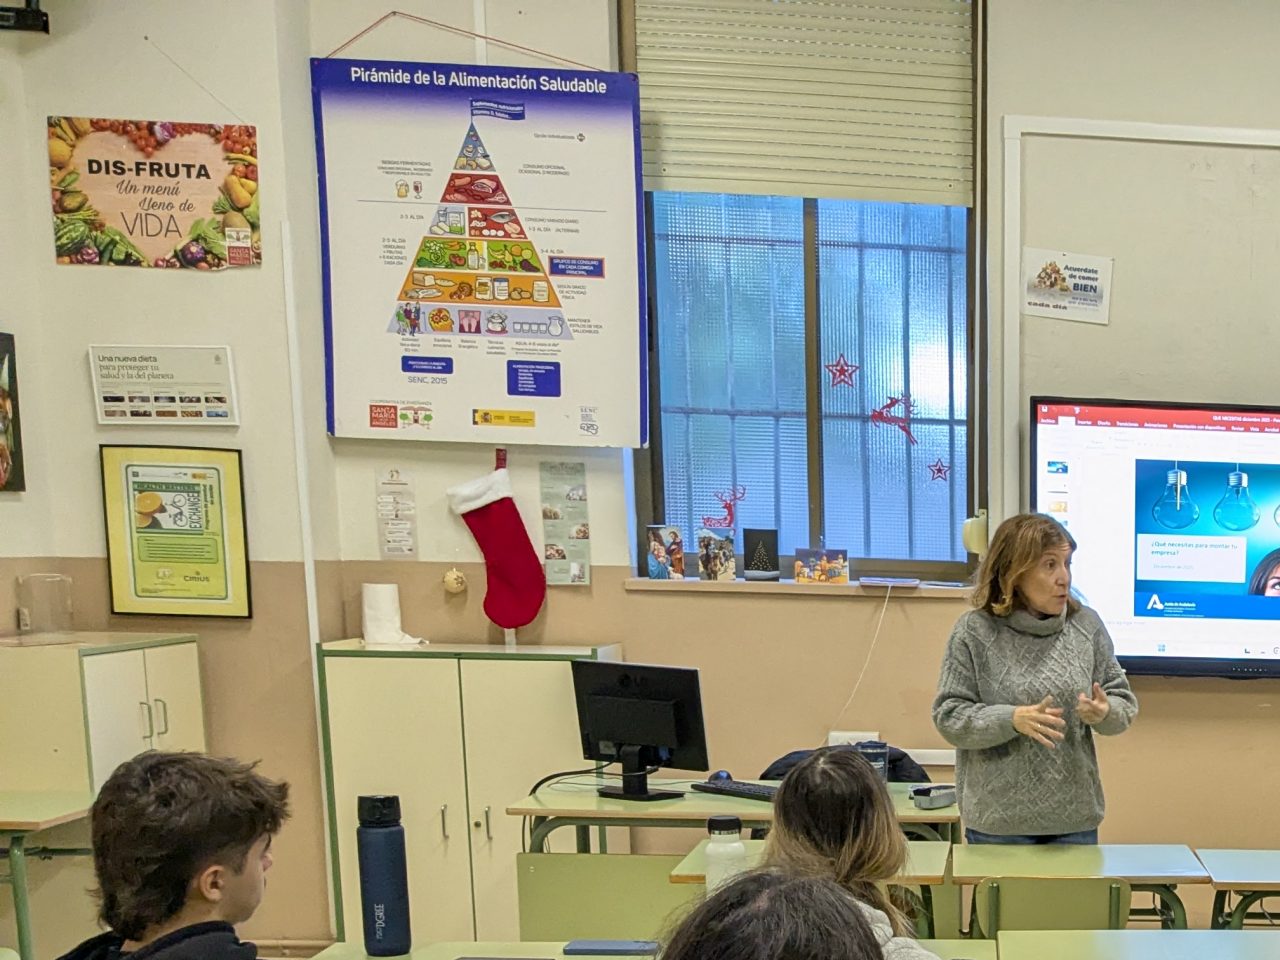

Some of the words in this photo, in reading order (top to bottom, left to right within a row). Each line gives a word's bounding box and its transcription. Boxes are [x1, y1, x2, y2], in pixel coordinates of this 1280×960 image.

[350, 67, 411, 84] Pirámide
[414, 69, 430, 85] de
[434, 70, 446, 86] la
[448, 71, 537, 90] Alimentación
[540, 77, 607, 94] Saludable
[88, 159, 211, 180] DIS-FRUTA
[116, 180, 139, 194] Un
[142, 181, 180, 196] menú
[179, 199, 196, 212] de
[120, 212, 182, 238] VIDA
[1073, 283, 1097, 293] BIEN
[147, 372, 174, 380] planeta
[432, 377, 448, 385] 2015
[188, 492, 202, 528] EXCHANGE
